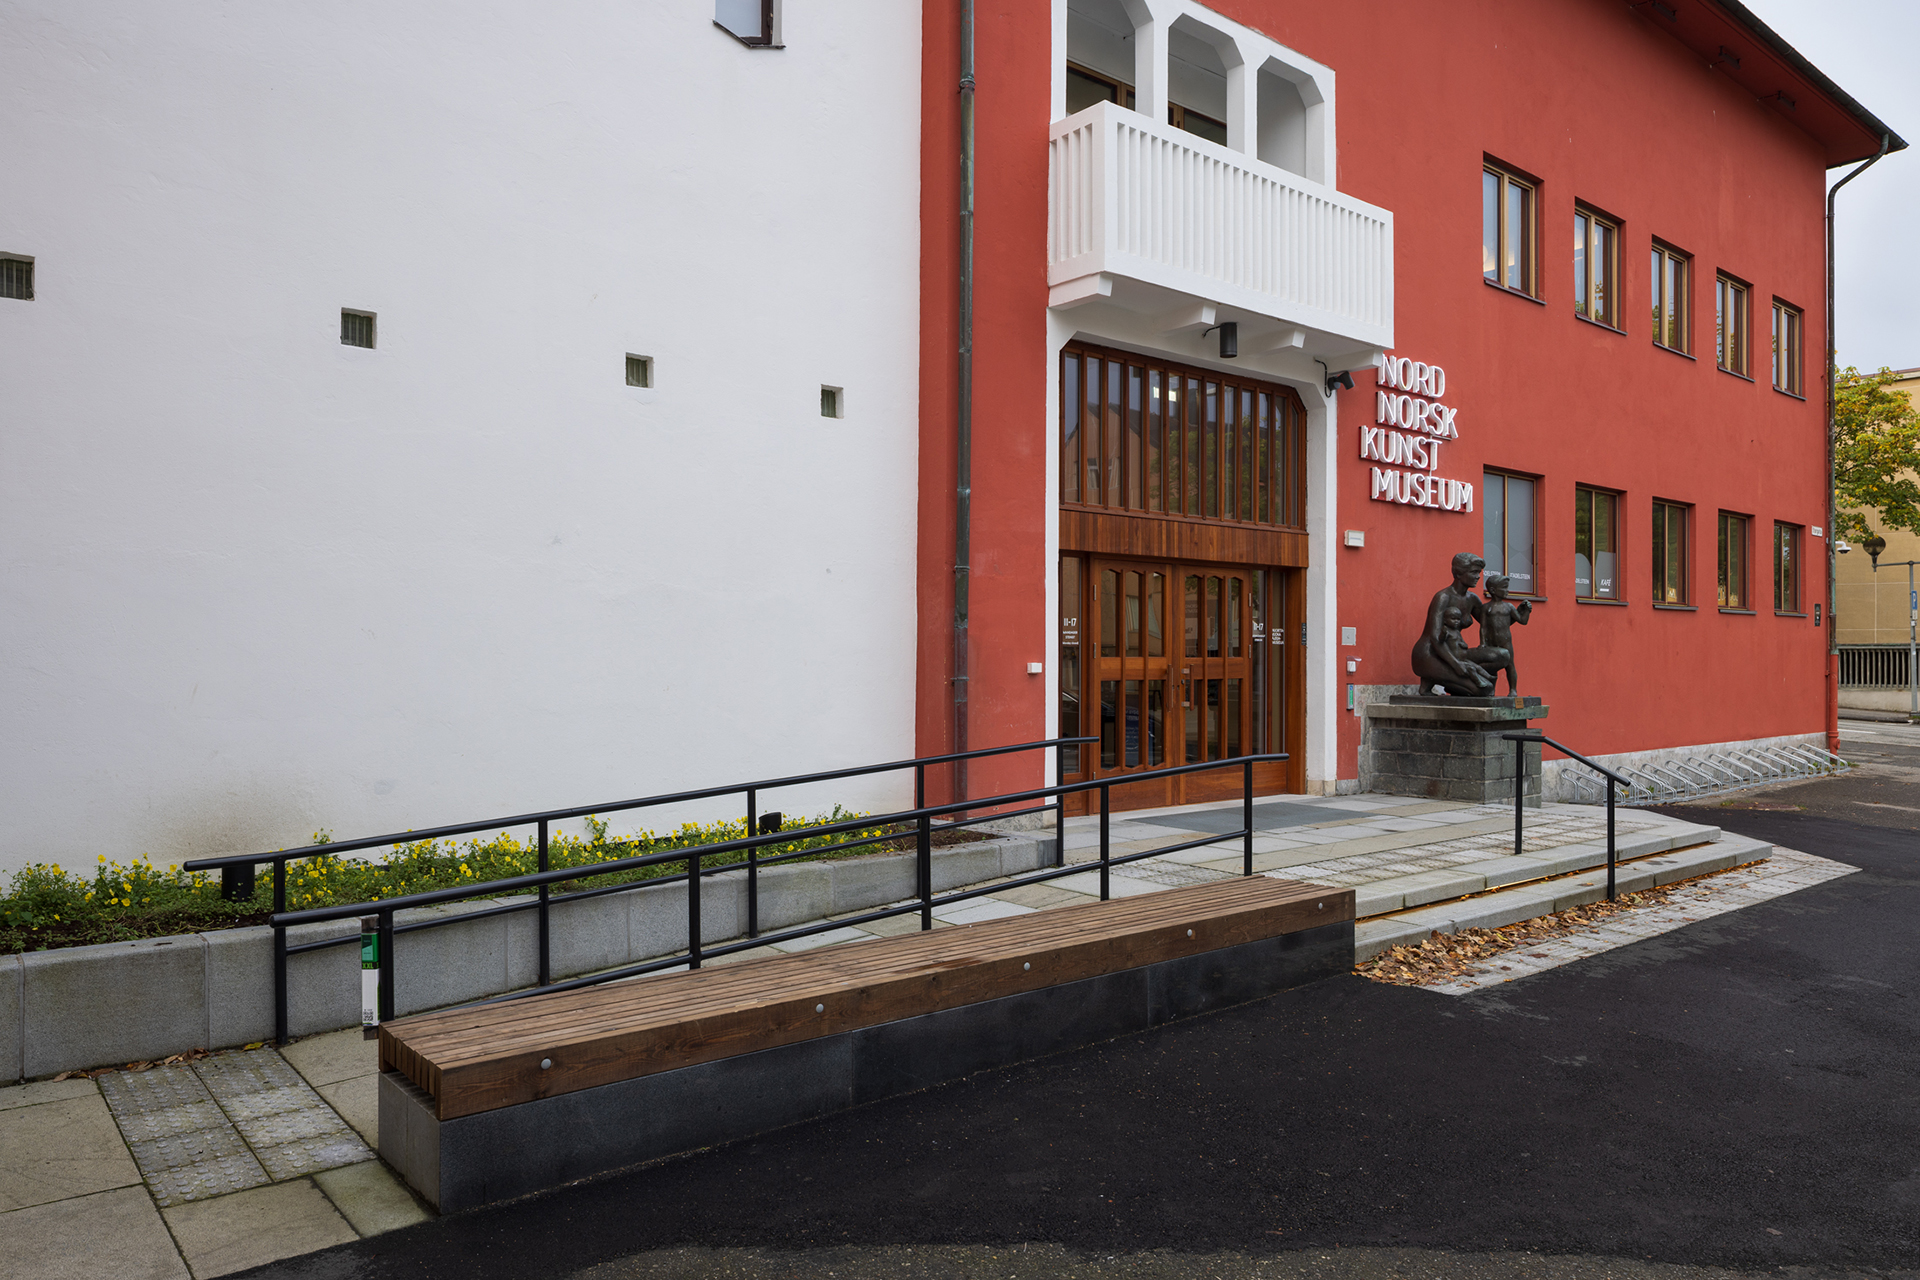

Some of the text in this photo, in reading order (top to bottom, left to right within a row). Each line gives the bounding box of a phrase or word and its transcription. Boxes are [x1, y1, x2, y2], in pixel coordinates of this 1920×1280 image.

[1376, 353, 1446, 398] NORD
[1376, 390, 1459, 438] NORSK
[1360, 425, 1443, 471] KUNST
[1371, 466, 1474, 513] MUSEUM
